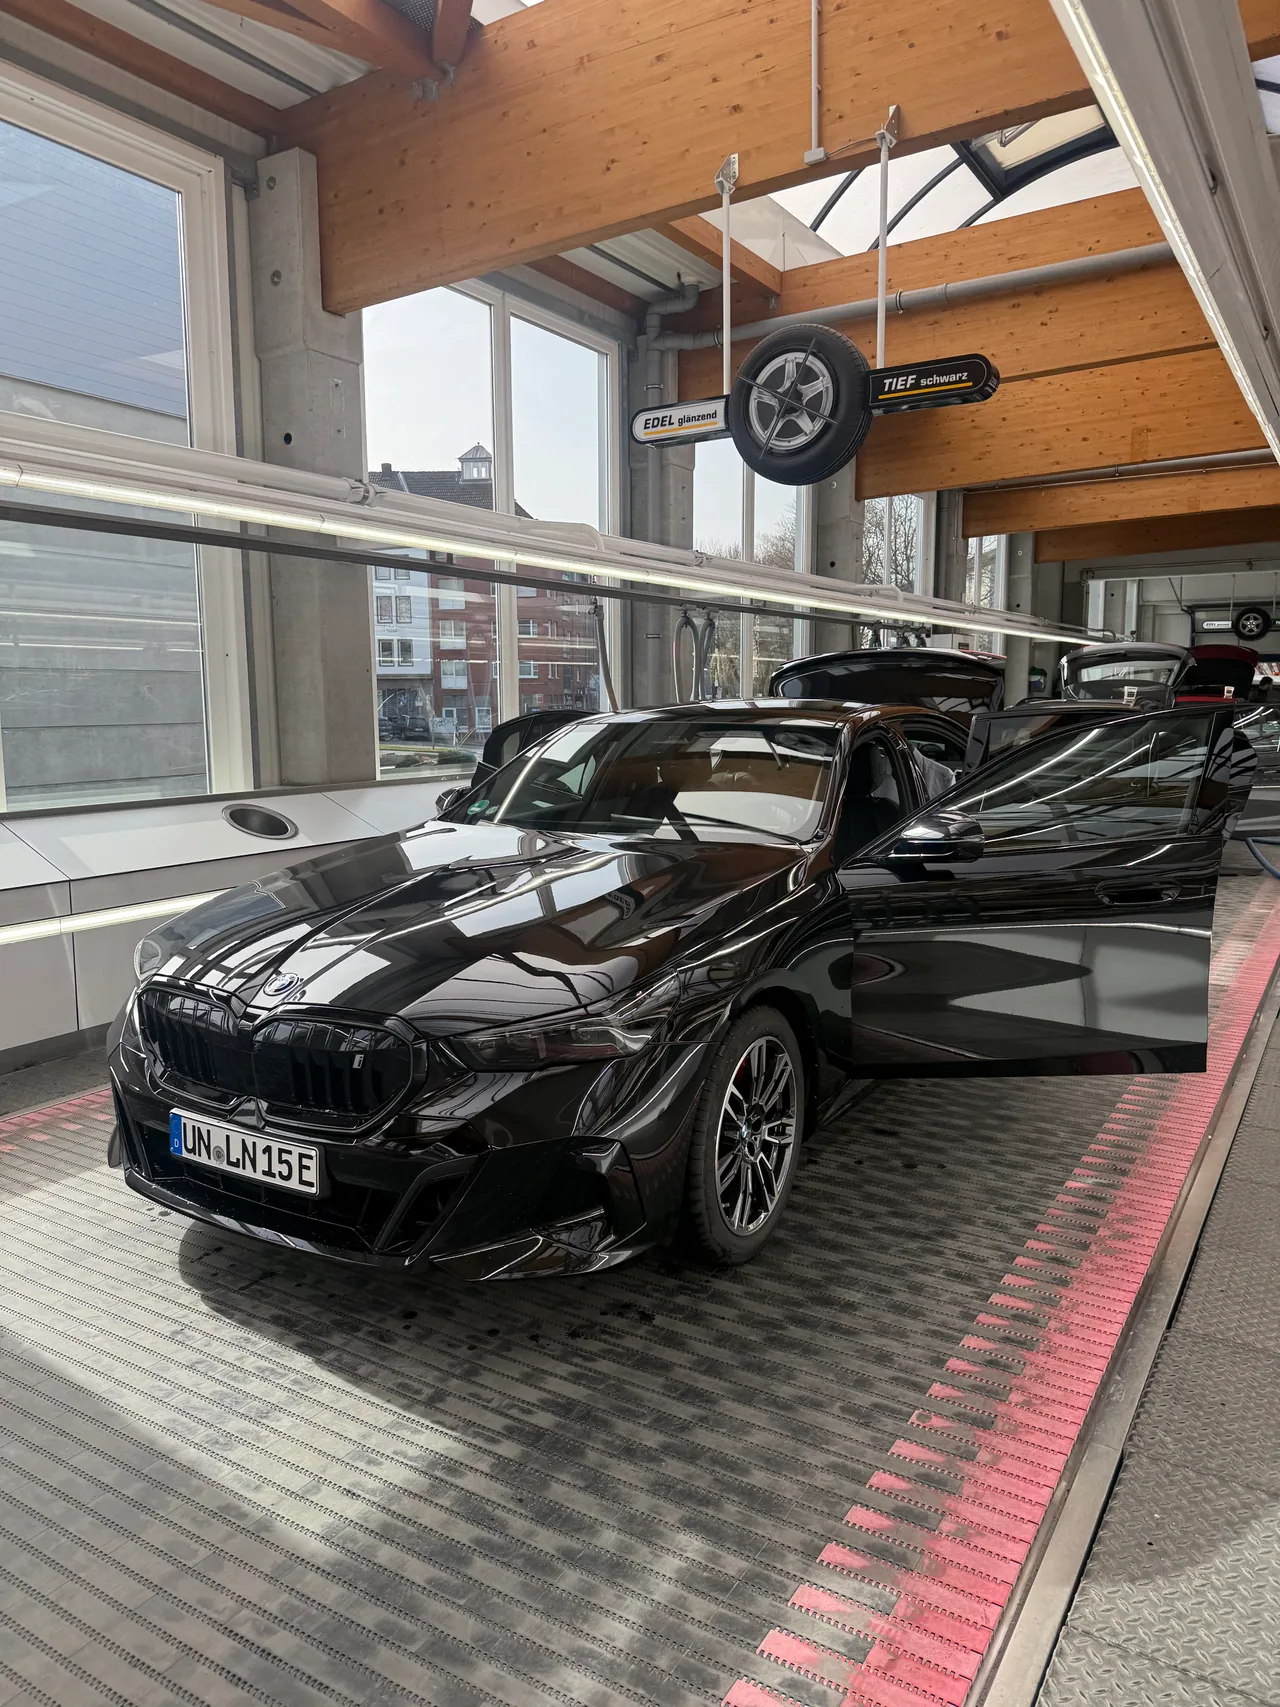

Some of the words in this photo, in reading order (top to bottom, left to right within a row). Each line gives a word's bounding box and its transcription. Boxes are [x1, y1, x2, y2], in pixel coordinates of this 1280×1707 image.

[883, 375, 917, 391] TIEF
[920, 372, 968, 386] schwarz
[643, 415, 675, 429] EDEL
[677, 410, 718, 427] glänzend
[174, 1138, 180, 1148] D
[183, 1122, 211, 1160] UN
